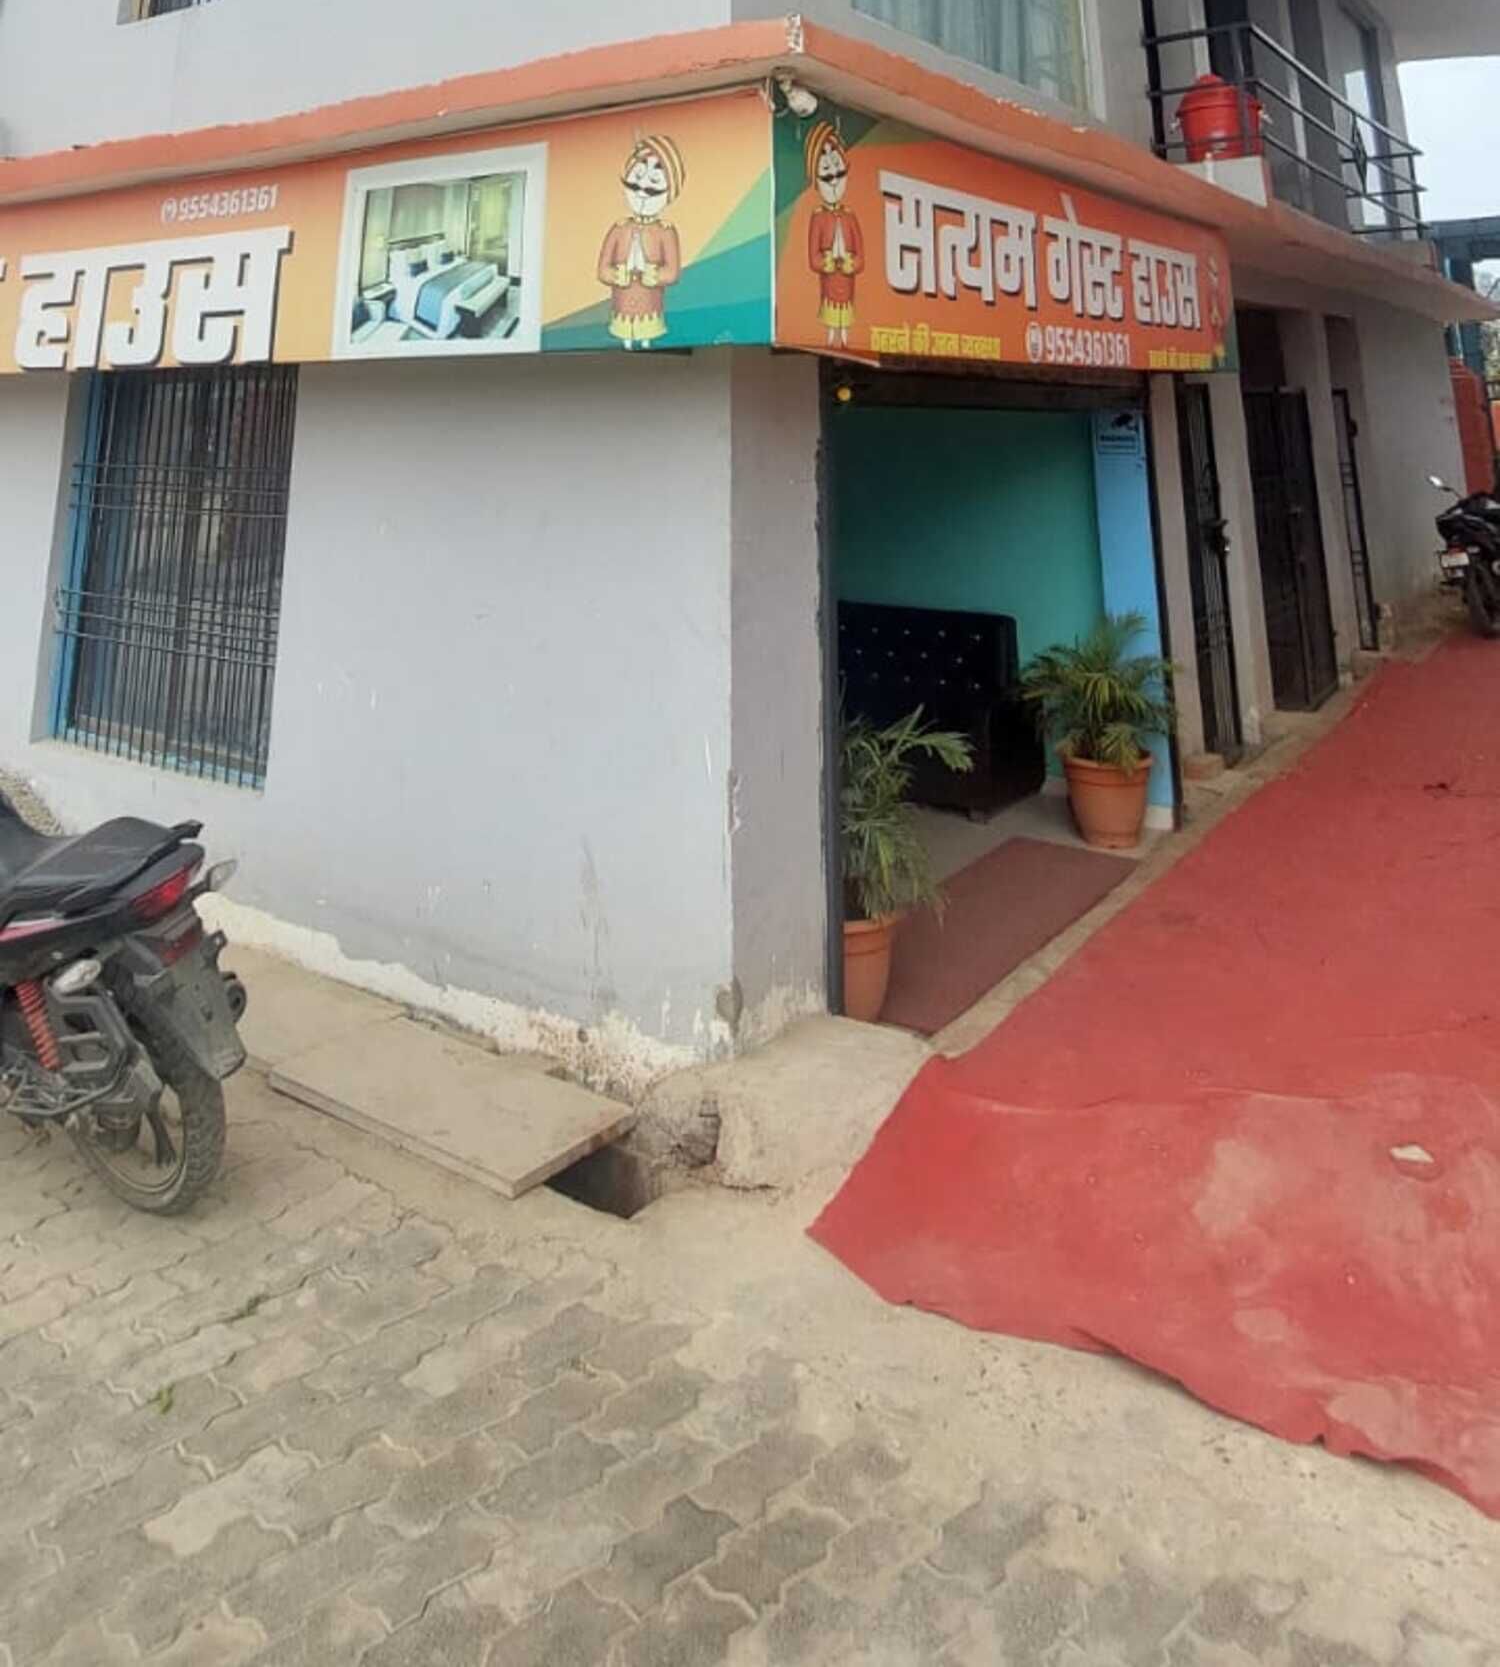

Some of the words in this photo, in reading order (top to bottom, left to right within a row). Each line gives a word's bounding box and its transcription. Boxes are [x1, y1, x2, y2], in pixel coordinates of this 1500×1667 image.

[178, 184, 279, 222] 9554361361
[15, 225, 293, 369] हाउस
[877, 170, 1037, 309] सत्यम
[1042, 192, 1127, 320] गेस्ट
[1127, 238, 1202, 332] हाउस
[1043, 325, 1131, 367] 9554361361
